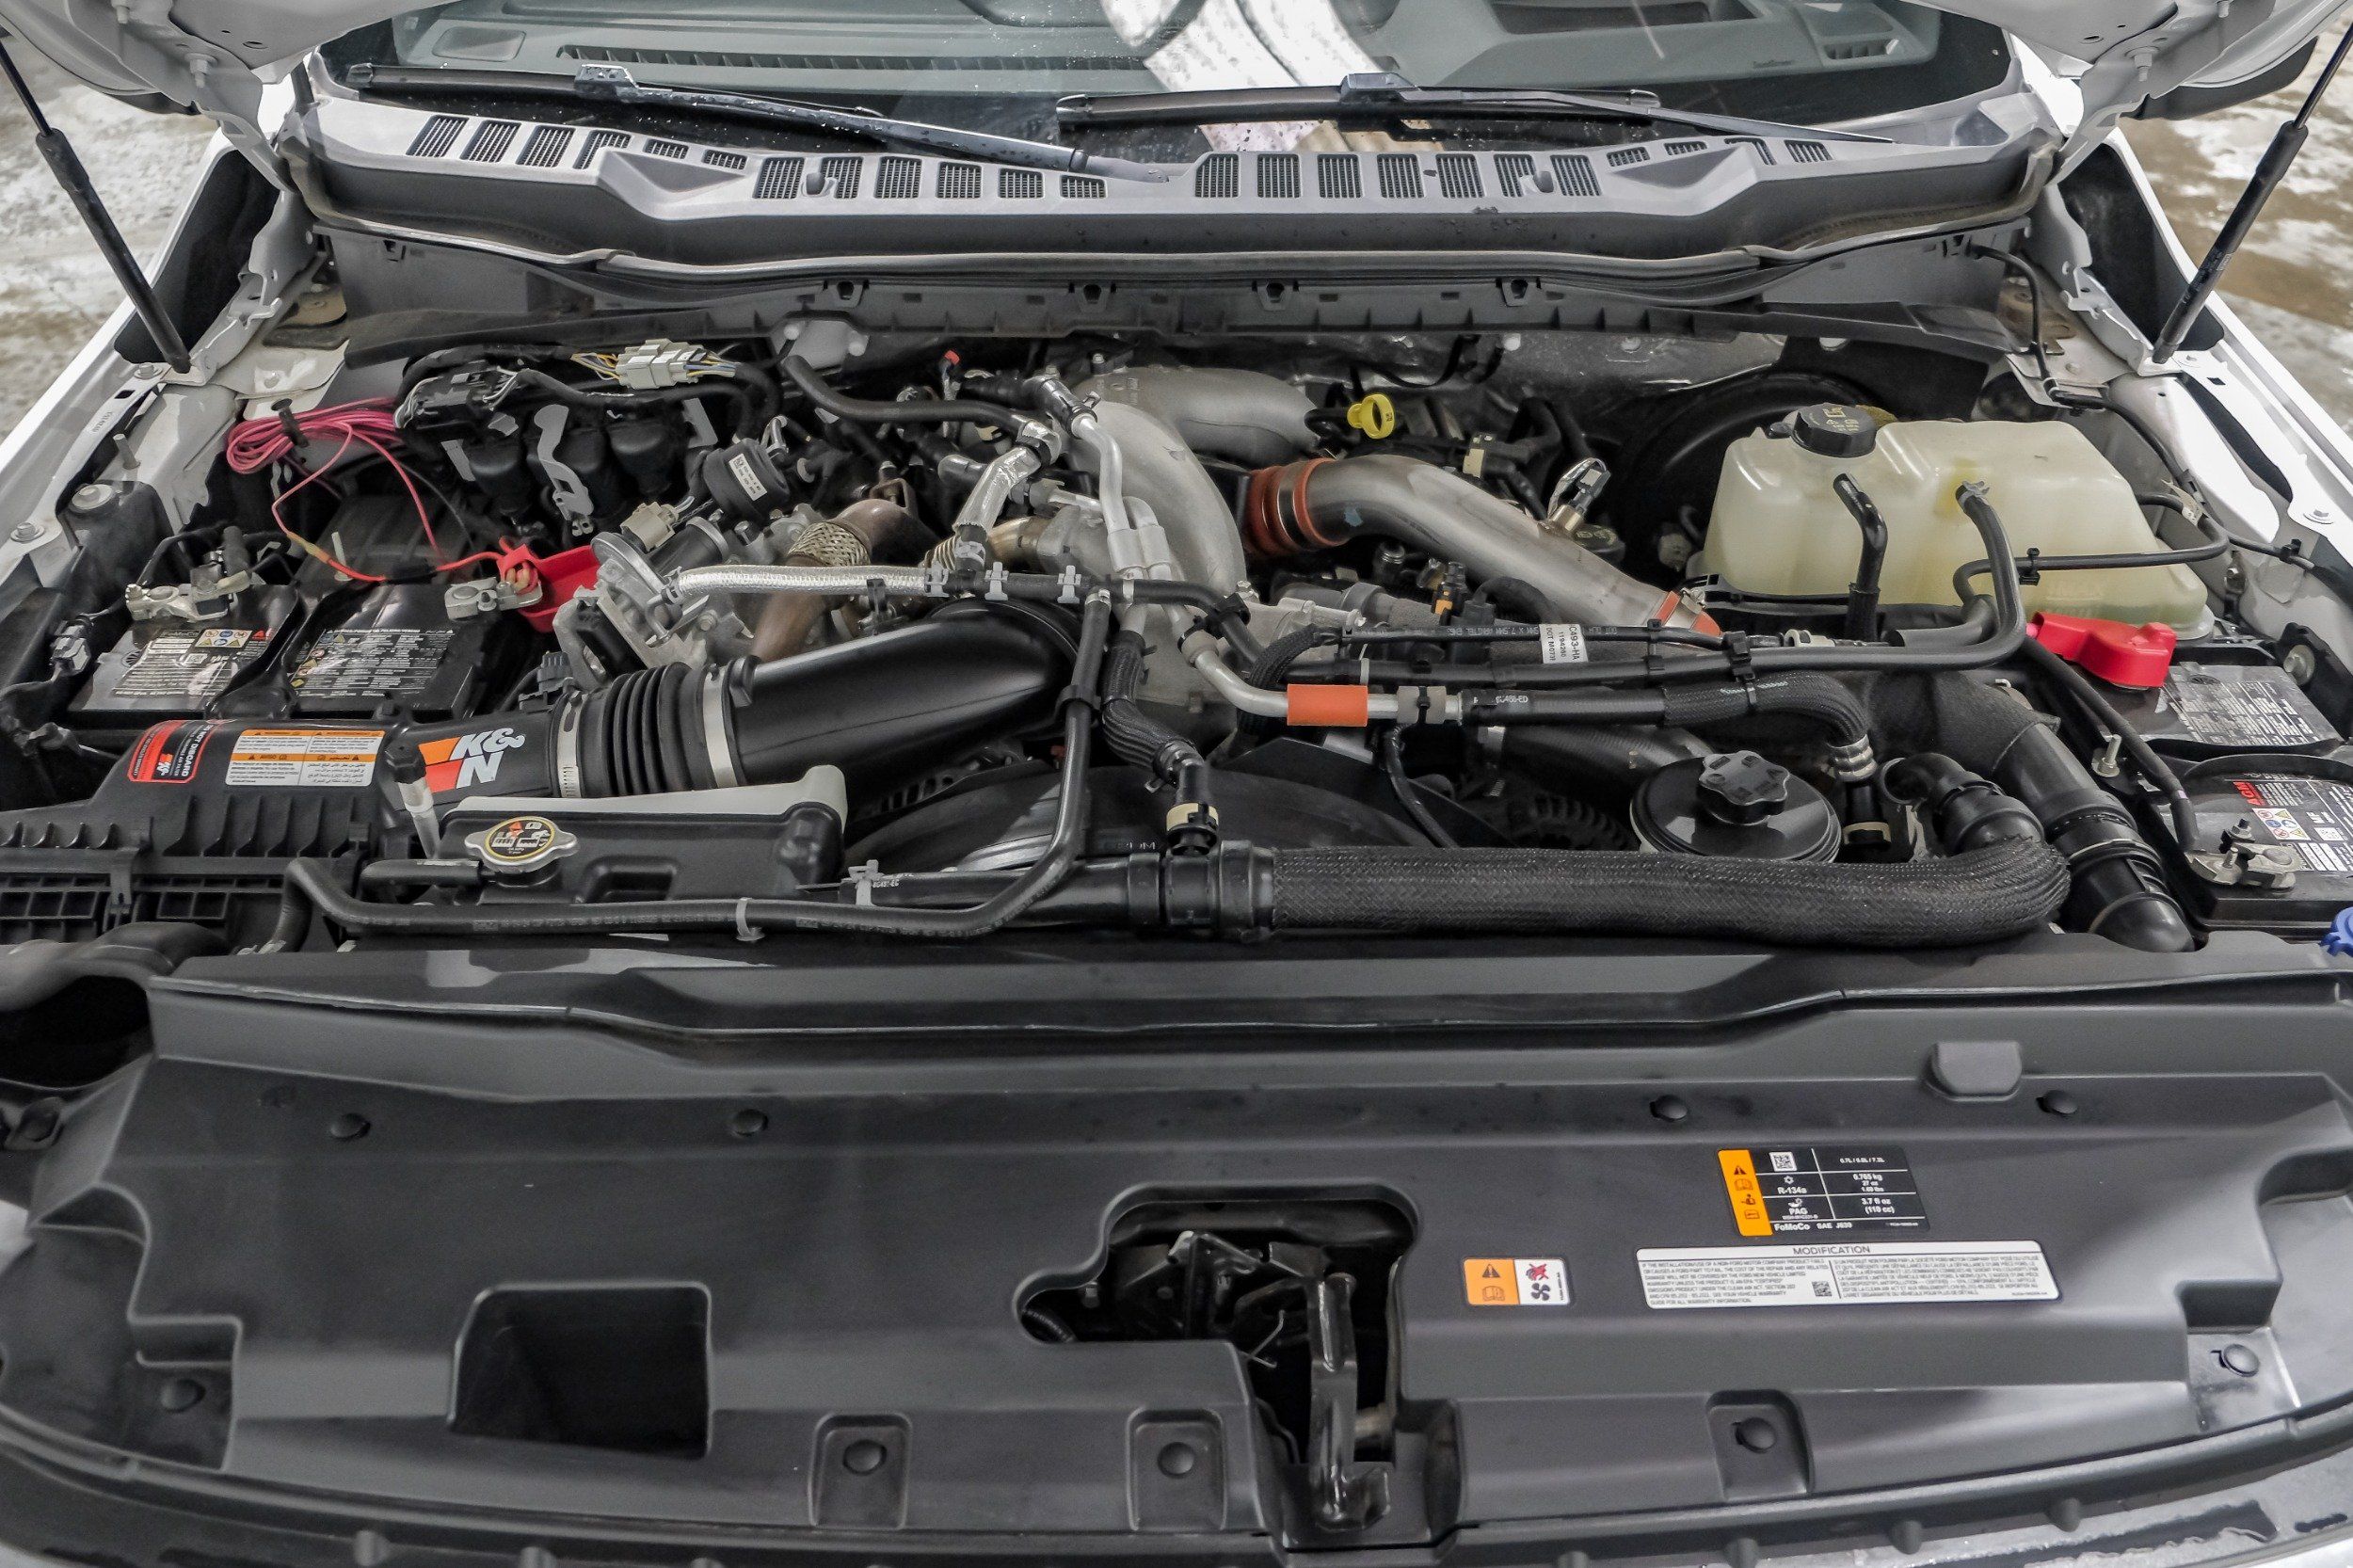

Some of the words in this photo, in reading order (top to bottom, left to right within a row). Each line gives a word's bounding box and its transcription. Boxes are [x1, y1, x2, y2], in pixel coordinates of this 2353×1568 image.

[195, 730, 207, 743] NOT
[449, 728, 526, 790] K&N
[1777, 1186, 1807, 1195] R-134a
[1774, 1222, 1811, 1231] FoMoCo
[1792, 1245, 1871, 1256] MODIFICATION
